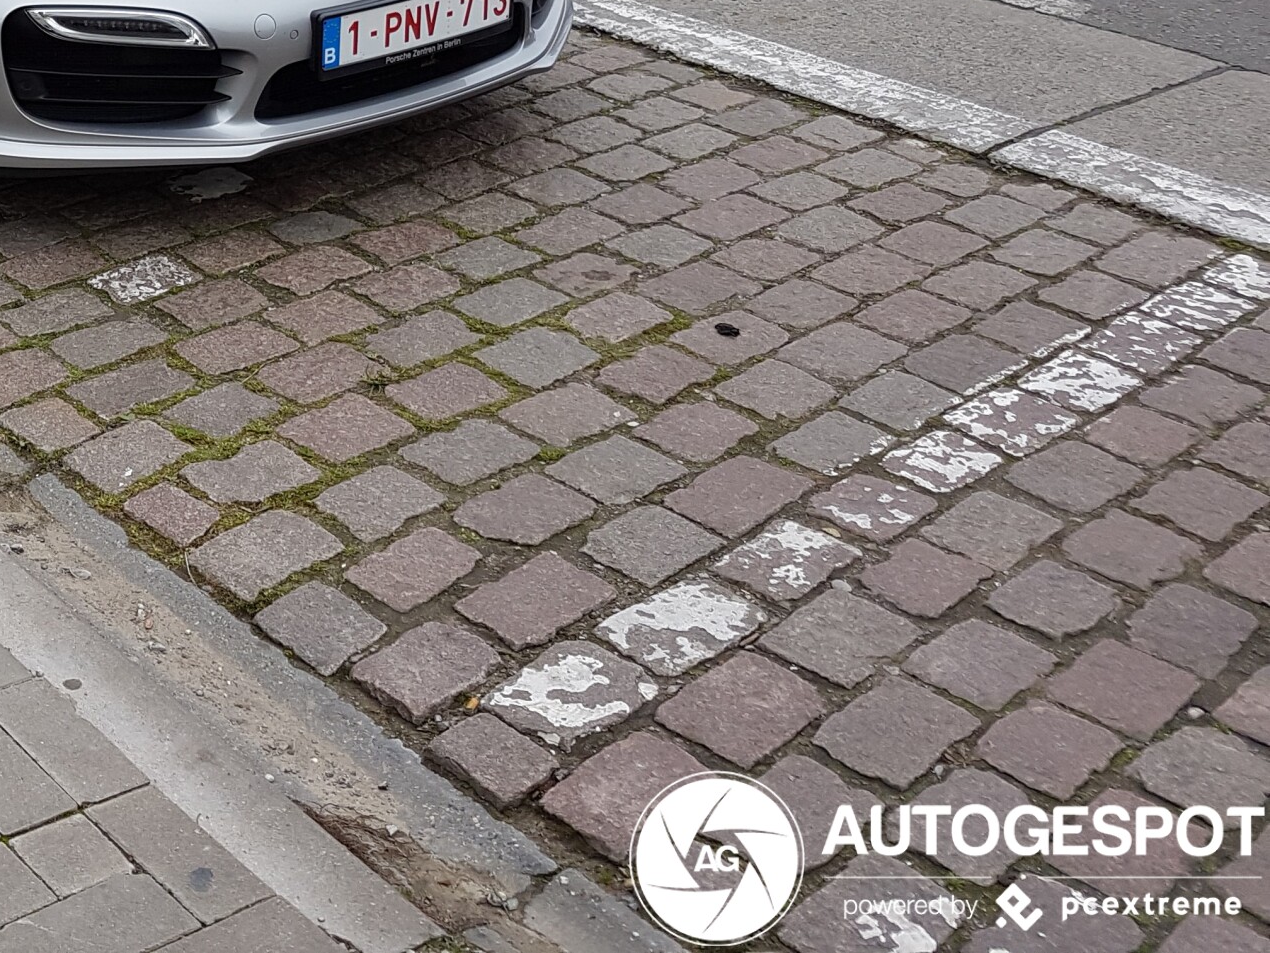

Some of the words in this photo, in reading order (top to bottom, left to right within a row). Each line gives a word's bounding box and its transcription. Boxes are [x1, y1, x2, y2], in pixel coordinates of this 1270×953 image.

[325, 47, 336, 64] B
[385, 52, 411, 64] Porsche
[413, 45, 435, 57] Zentren
[444, 38, 461, 48] Berlin
